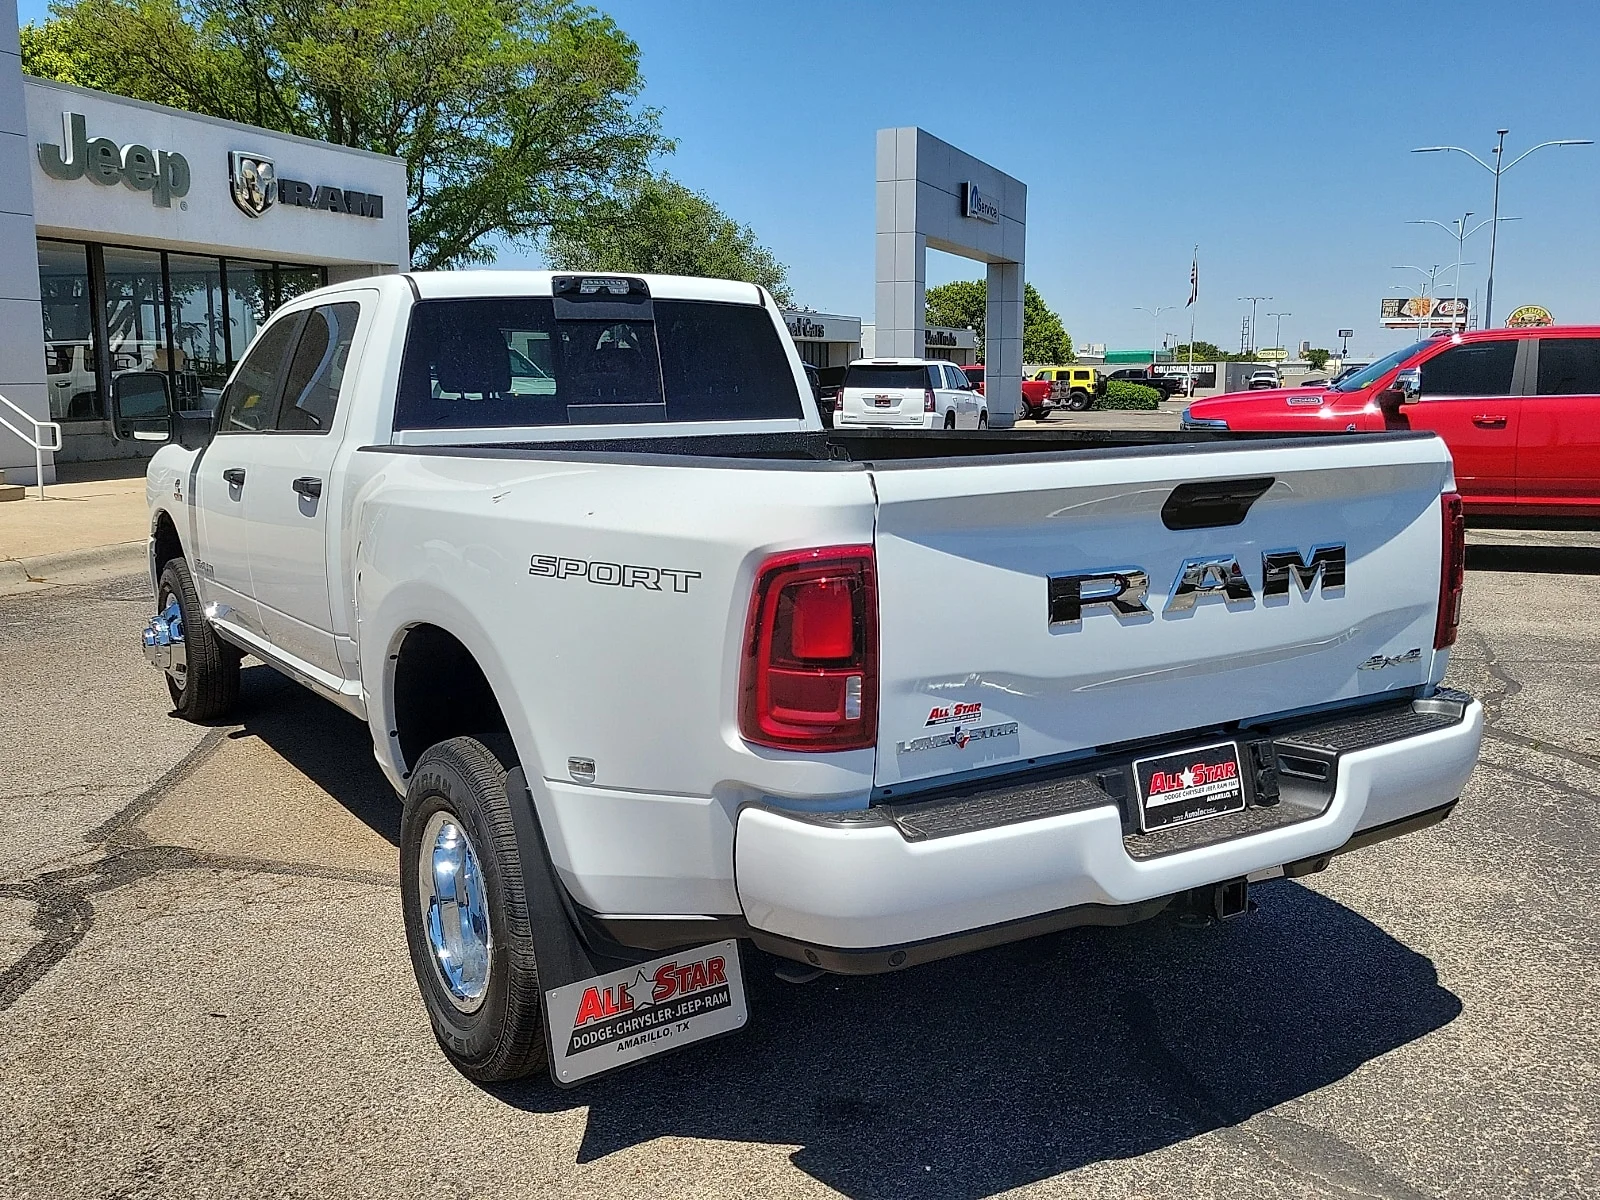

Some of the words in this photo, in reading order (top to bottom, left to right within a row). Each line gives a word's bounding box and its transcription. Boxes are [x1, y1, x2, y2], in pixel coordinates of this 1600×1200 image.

[37, 111, 191, 208] Jeep
[278, 178, 384, 219] RAM
[978, 198, 997, 219] Service
[1154, 365, 1188, 374] COLLISION
[1189, 365, 1214, 373] CENTER
[529, 554, 702, 593] SPORT
[1047, 541, 1347, 635] RAM
[1164, 791, 1181, 801] DODGE
[1182, 786, 1205, 798] CHRYSLER
[1217, 781, 1228, 790] RAM
[1191, 762, 1236, 785] STAR
[574, 983, 634, 1028] ALL
[652, 956, 729, 1001] STAR
[616, 1027, 674, 1052] AMARILLO,
[675, 1020, 691, 1033] TX
